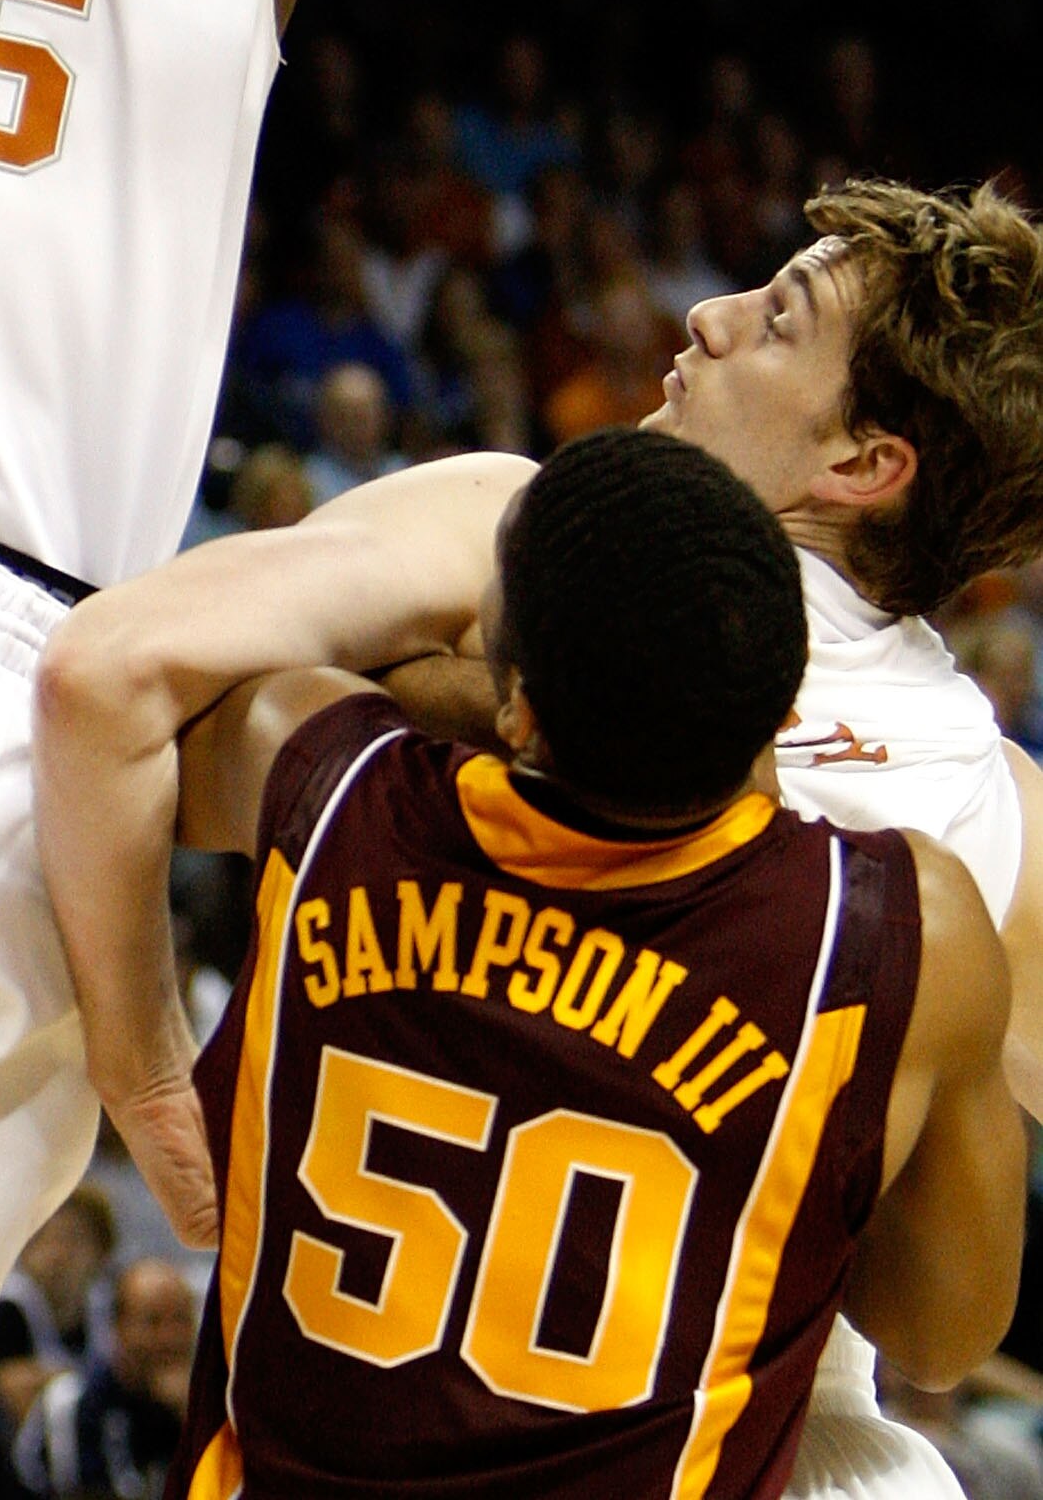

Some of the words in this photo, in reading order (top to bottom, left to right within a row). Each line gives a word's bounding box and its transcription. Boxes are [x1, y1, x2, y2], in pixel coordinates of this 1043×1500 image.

[295, 880, 687, 1058] SAMPSON
[652, 996, 790, 1134] III
[282, 1045, 700, 1414] 50
